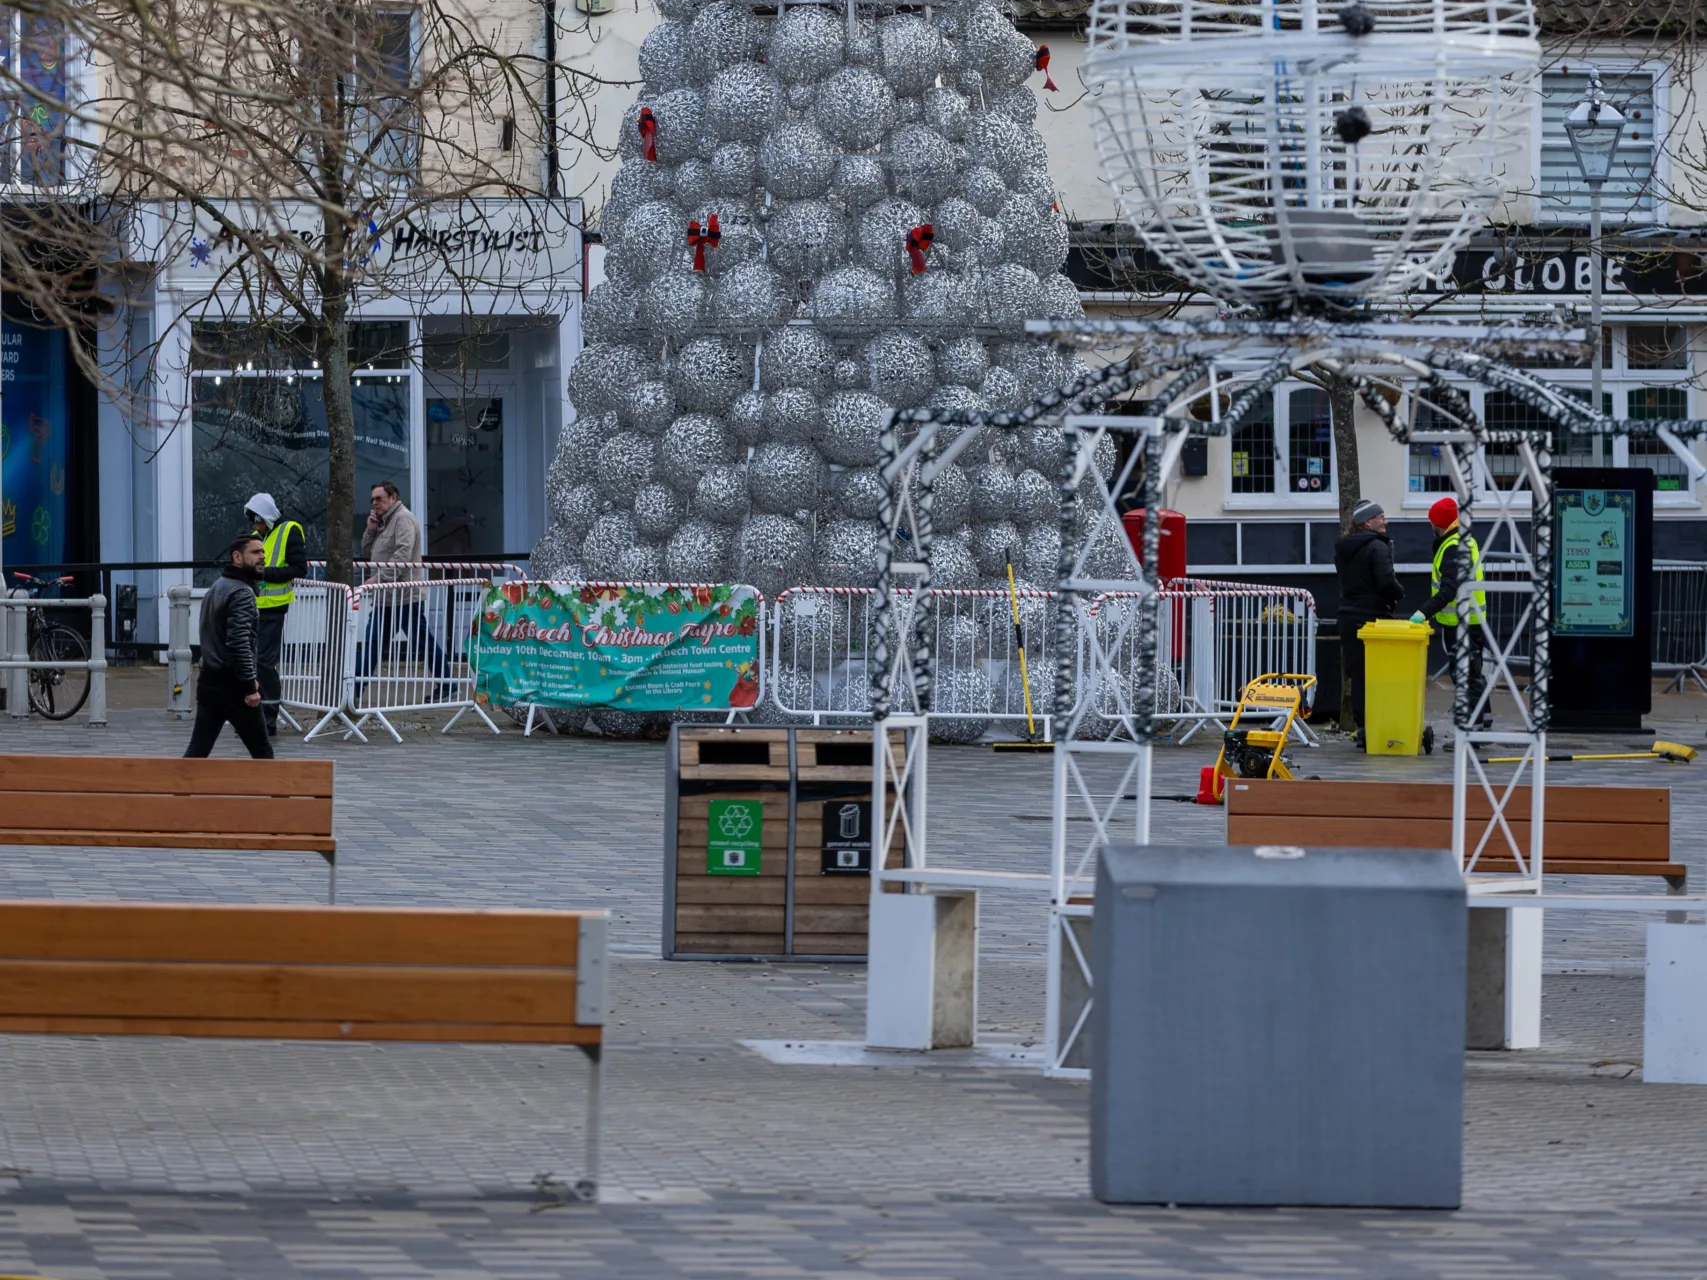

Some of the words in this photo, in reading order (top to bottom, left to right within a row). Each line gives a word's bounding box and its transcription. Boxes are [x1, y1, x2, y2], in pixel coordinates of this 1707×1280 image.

[394, 227, 543, 255] HAIRSTYLIST
[1481, 254, 1627, 291] GLOBE
[1, 333, 22, 346] ULAR
[1, 369, 15, 382] ERS
[293, 431, 316, 439] Tanning
[365, 436, 378, 445] Nail
[378, 439, 409, 453] Technician
[1567, 560, 1589, 569] ASDA
[491, 614, 572, 643] Wisbech
[576, 623, 674, 648] Christmas
[474, 644, 512, 656] Sunday
[515, 645, 537, 655] 10th
[539, 646, 585, 660] December,
[587, 651, 611, 662] 10am
[621, 654, 643, 664] 3pm
[690, 645, 717, 655] Town
[719, 644, 751, 654] Centre
[625, 683, 647, 691] Escape
